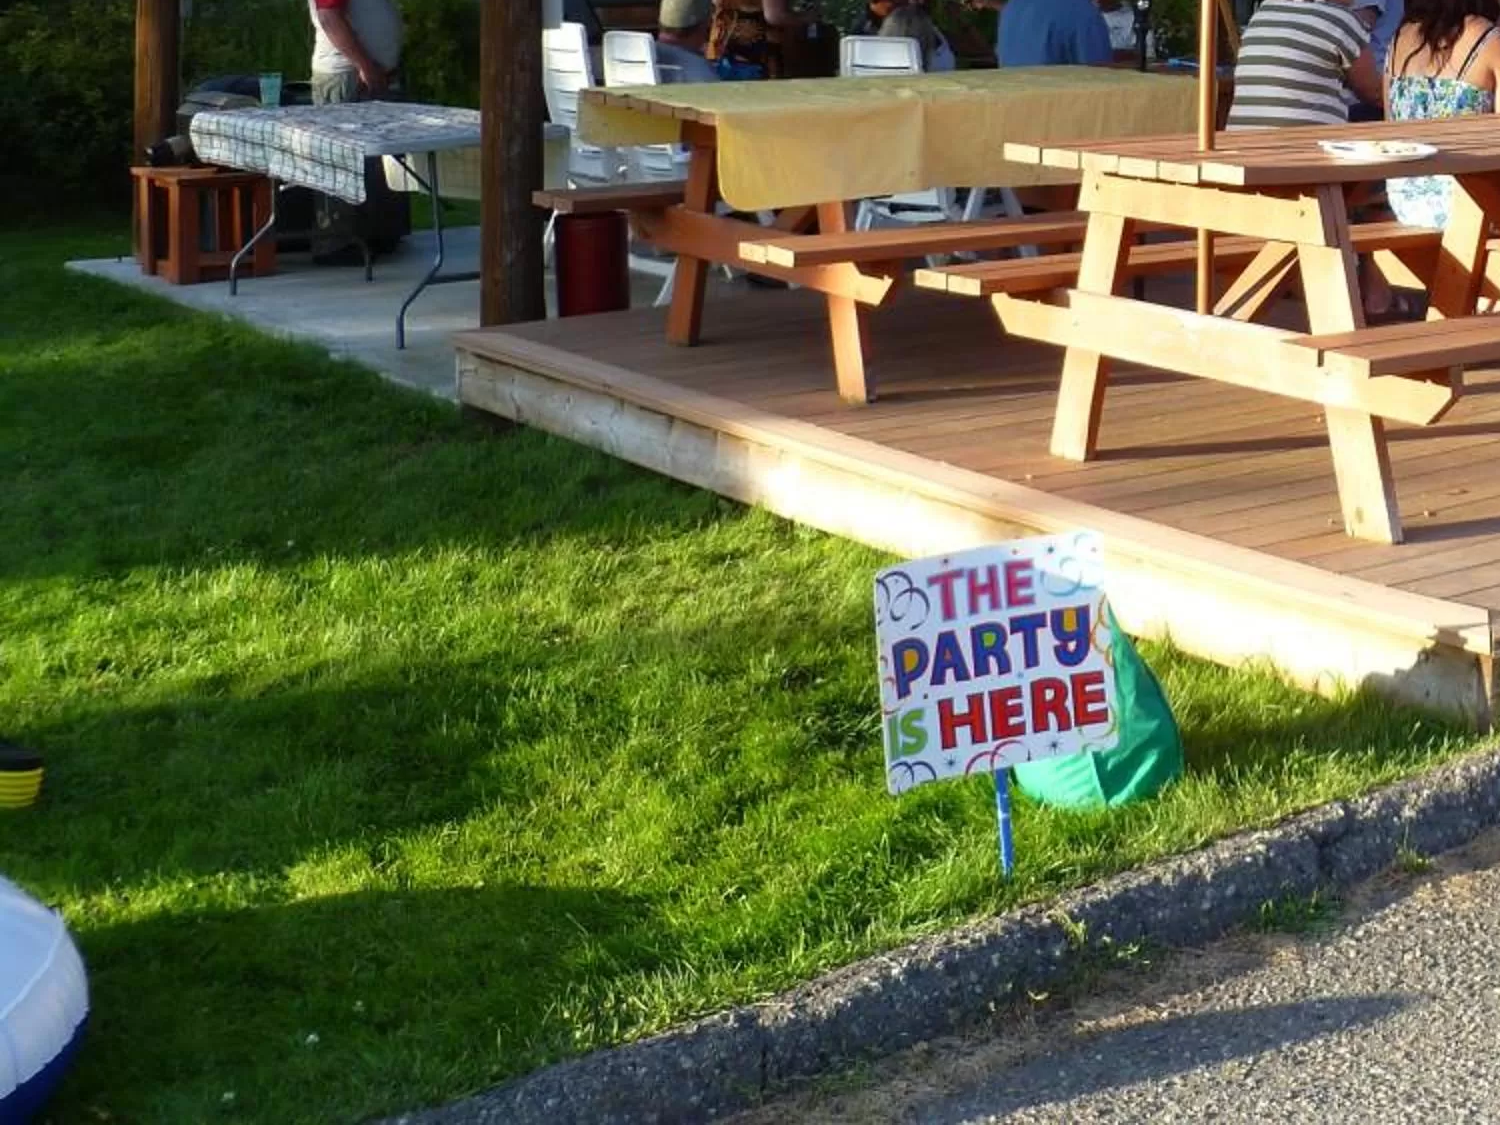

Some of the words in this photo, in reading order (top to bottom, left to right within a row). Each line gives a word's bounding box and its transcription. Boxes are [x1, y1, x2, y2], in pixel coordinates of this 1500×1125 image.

[928, 561, 1035, 621] THE
[892, 604, 1092, 700] PARTY
[887, 708, 929, 759] IS
[938, 670, 1109, 750] HERE
